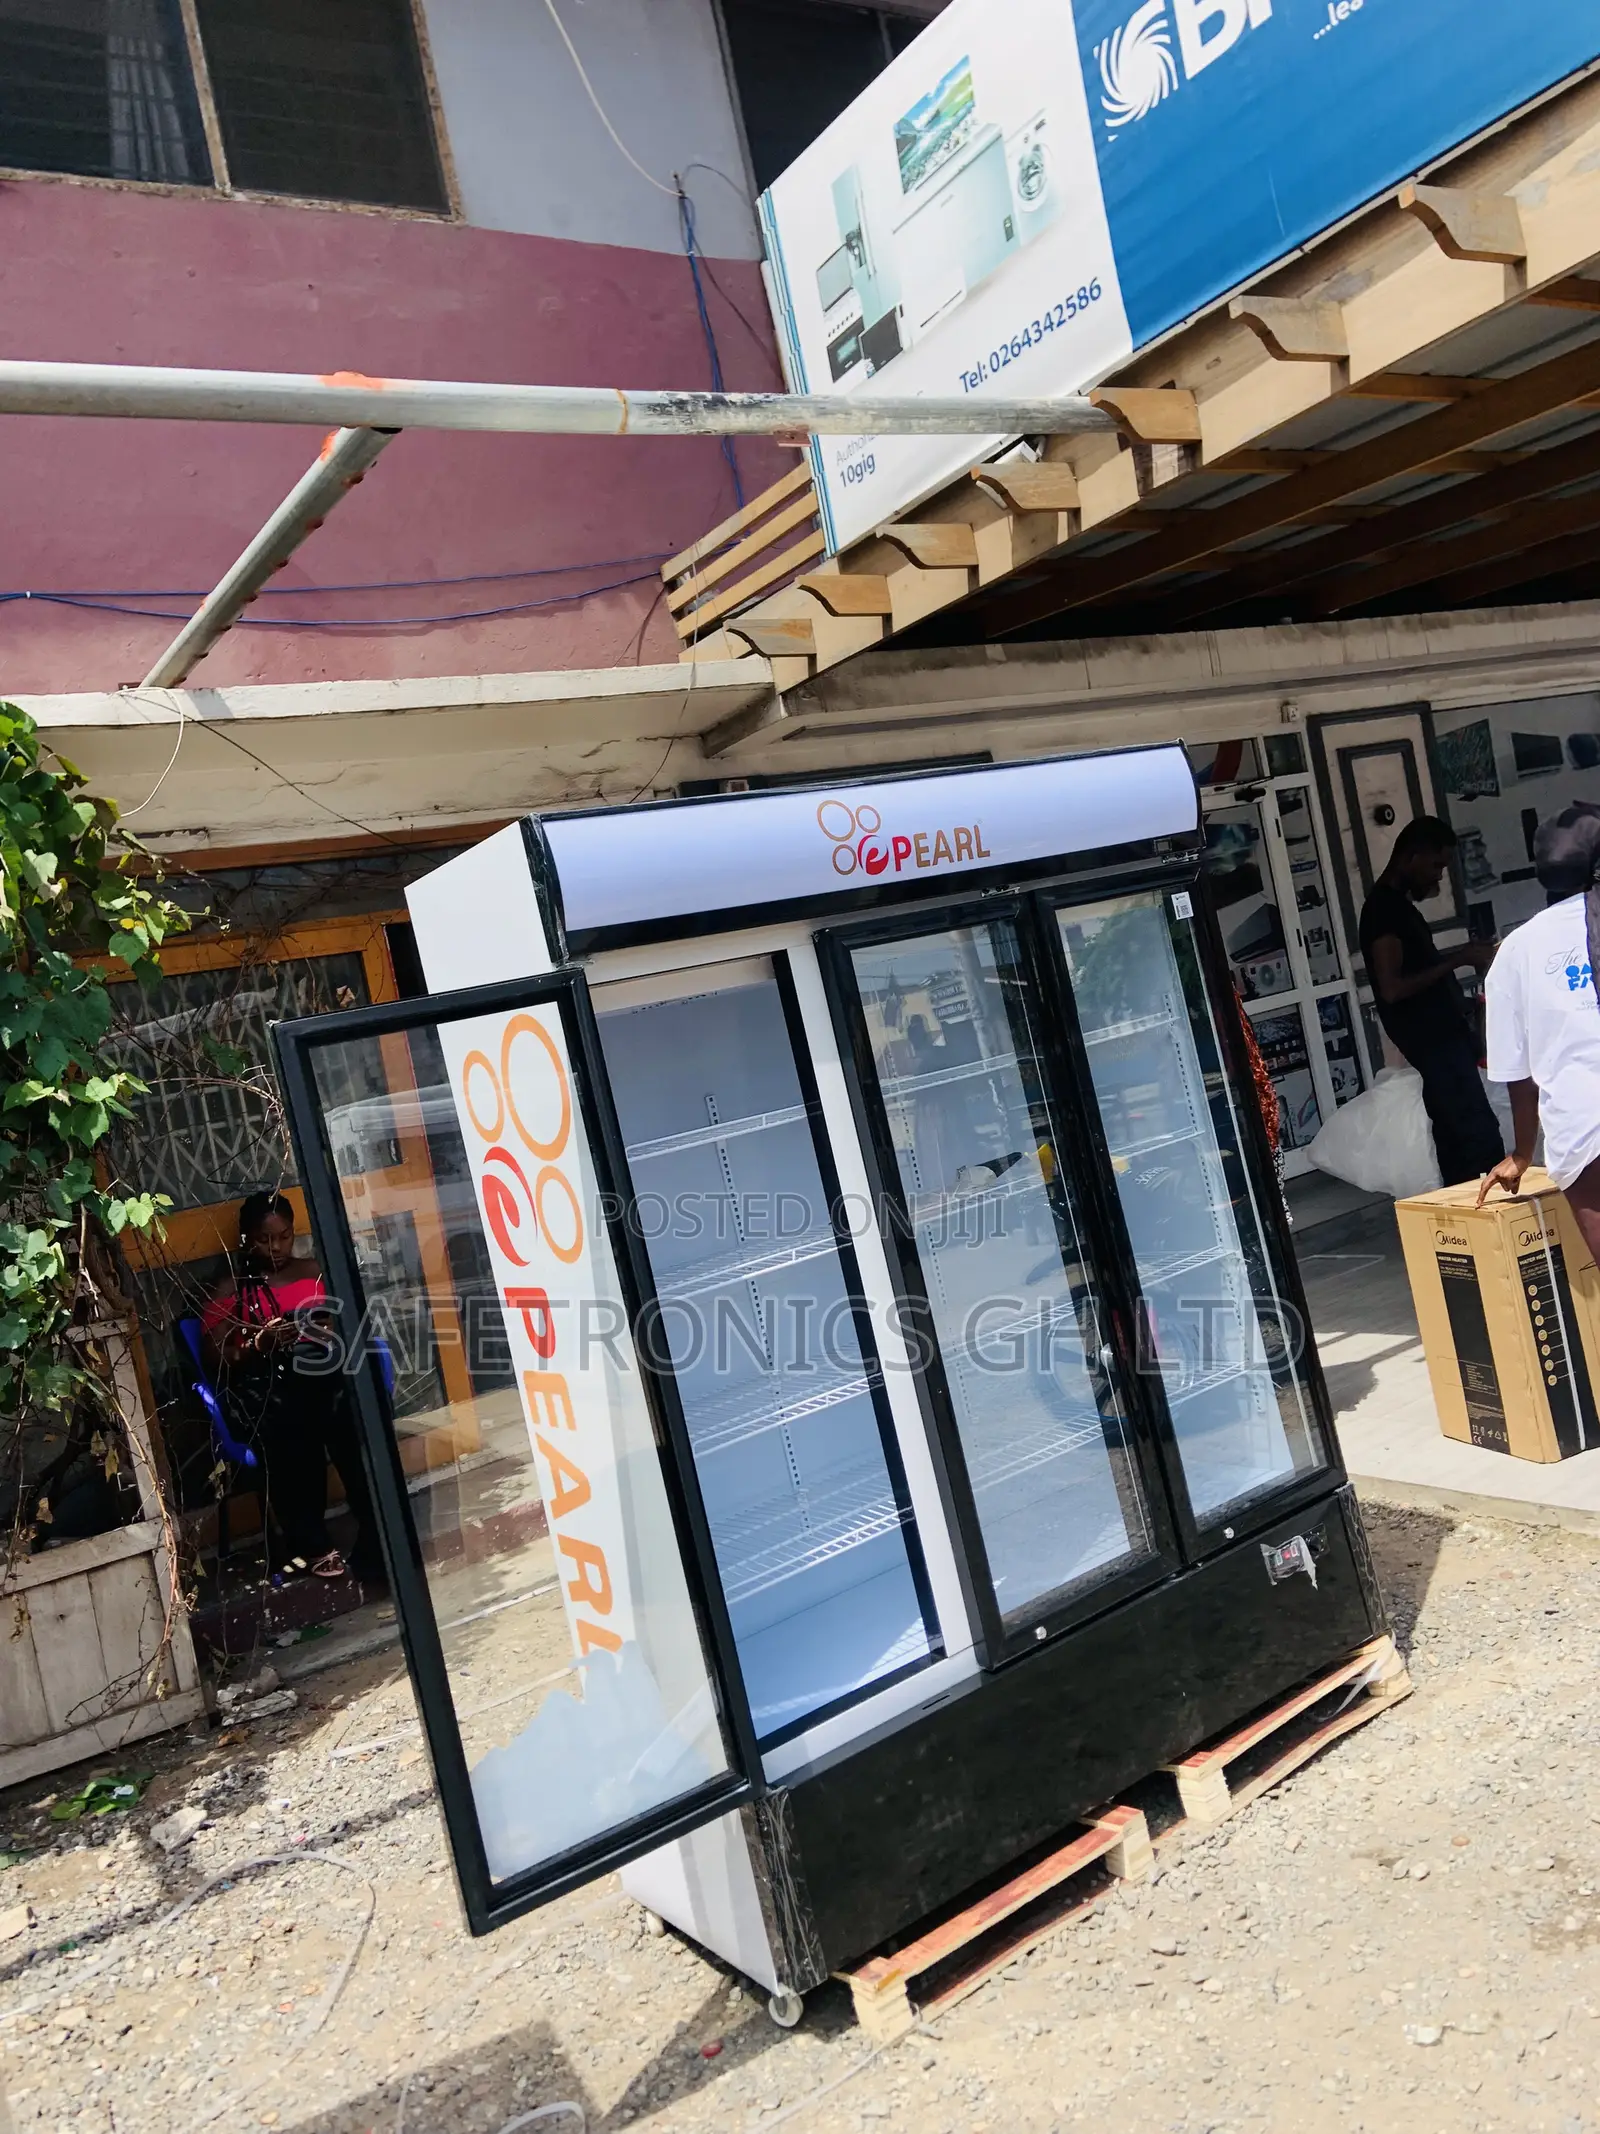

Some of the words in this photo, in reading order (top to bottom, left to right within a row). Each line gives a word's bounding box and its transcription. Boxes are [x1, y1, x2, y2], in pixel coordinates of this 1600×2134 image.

[959, 361, 988, 393] Tel:
[989, 276, 1102, 373] 0264342586
[839, 453, 876, 488] 10gig
[891, 824, 991, 872] PEARL
[1435, 1230, 1468, 1246] Midea
